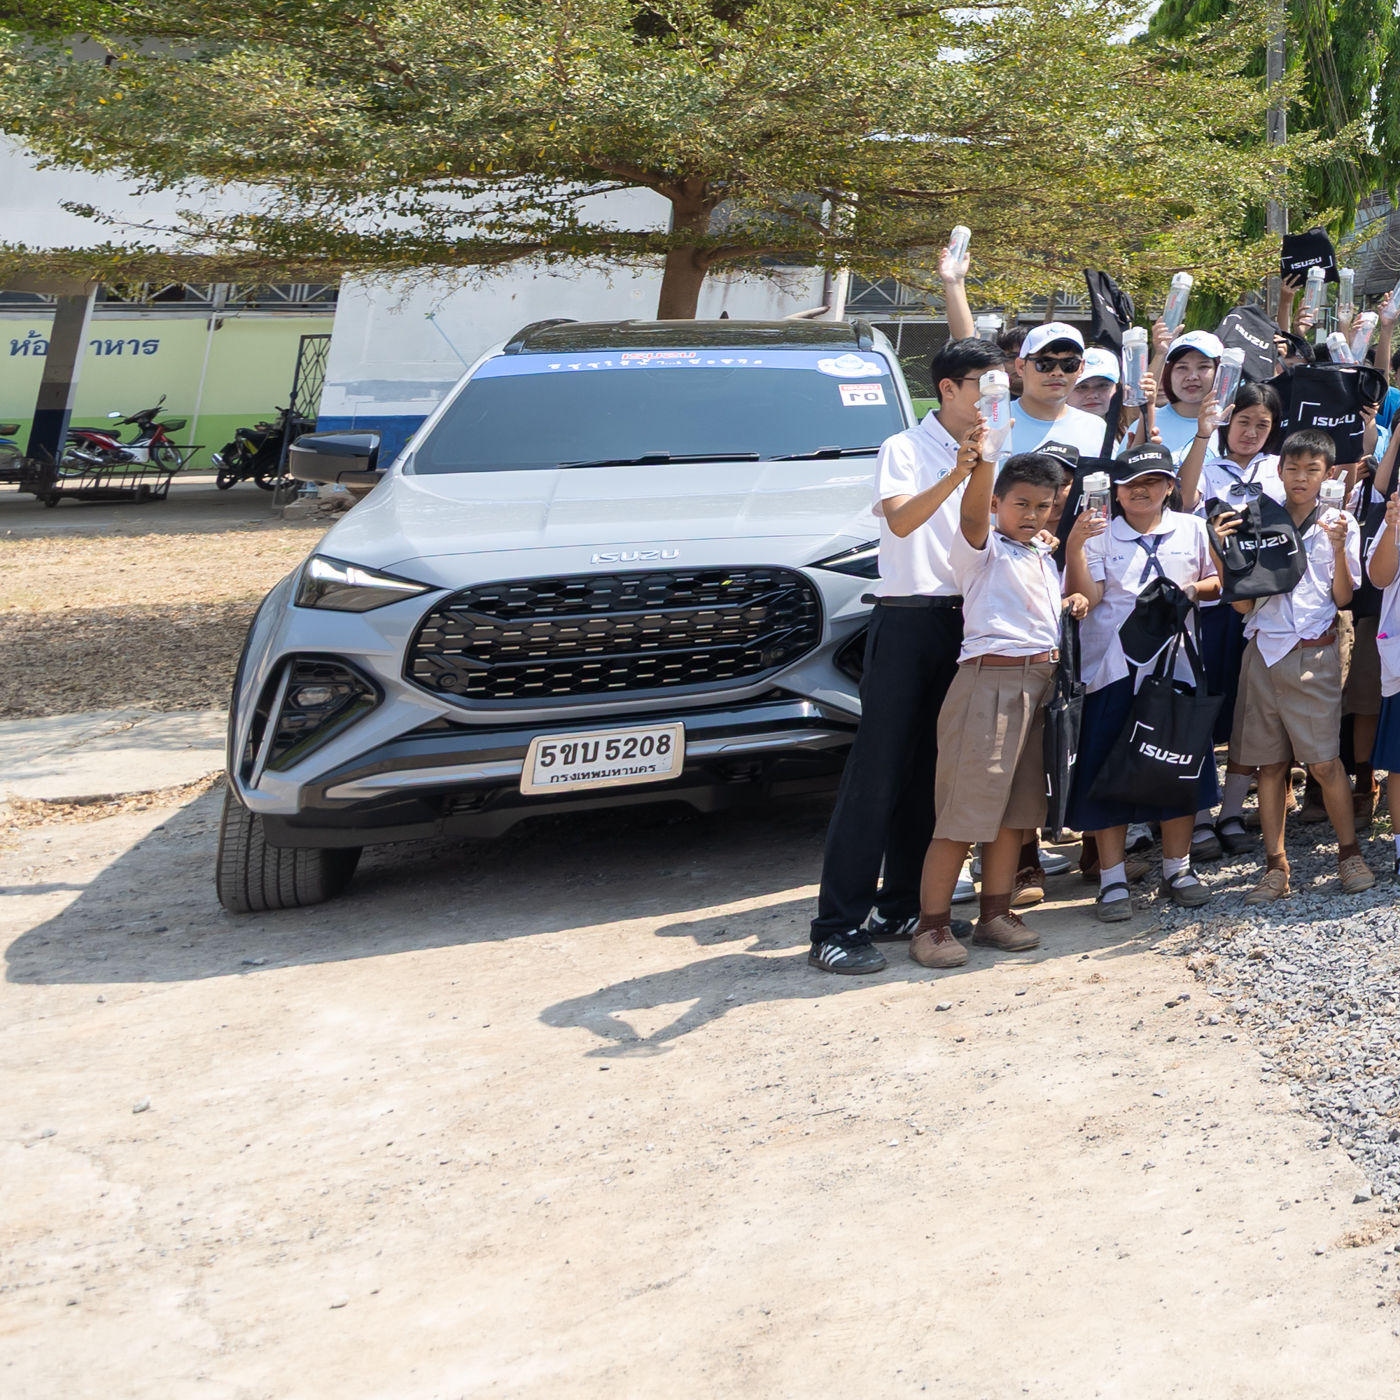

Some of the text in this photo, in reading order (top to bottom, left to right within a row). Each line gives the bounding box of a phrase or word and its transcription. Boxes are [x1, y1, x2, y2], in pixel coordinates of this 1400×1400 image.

[1291, 256, 1322, 270] ISUZU
[9, 329, 160, 356] ห้อาหาร
[1234, 323, 1270, 350] ISUZU
[1312, 414, 1356, 427] ISUZU
[1128, 453, 1162, 464] ISUZU
[1239, 534, 1288, 550] ISUZU
[590, 548, 680, 565] ISUZU
[540, 733, 671, 767] 5ขบ 5208
[1139, 742, 1192, 766] ISUZU
